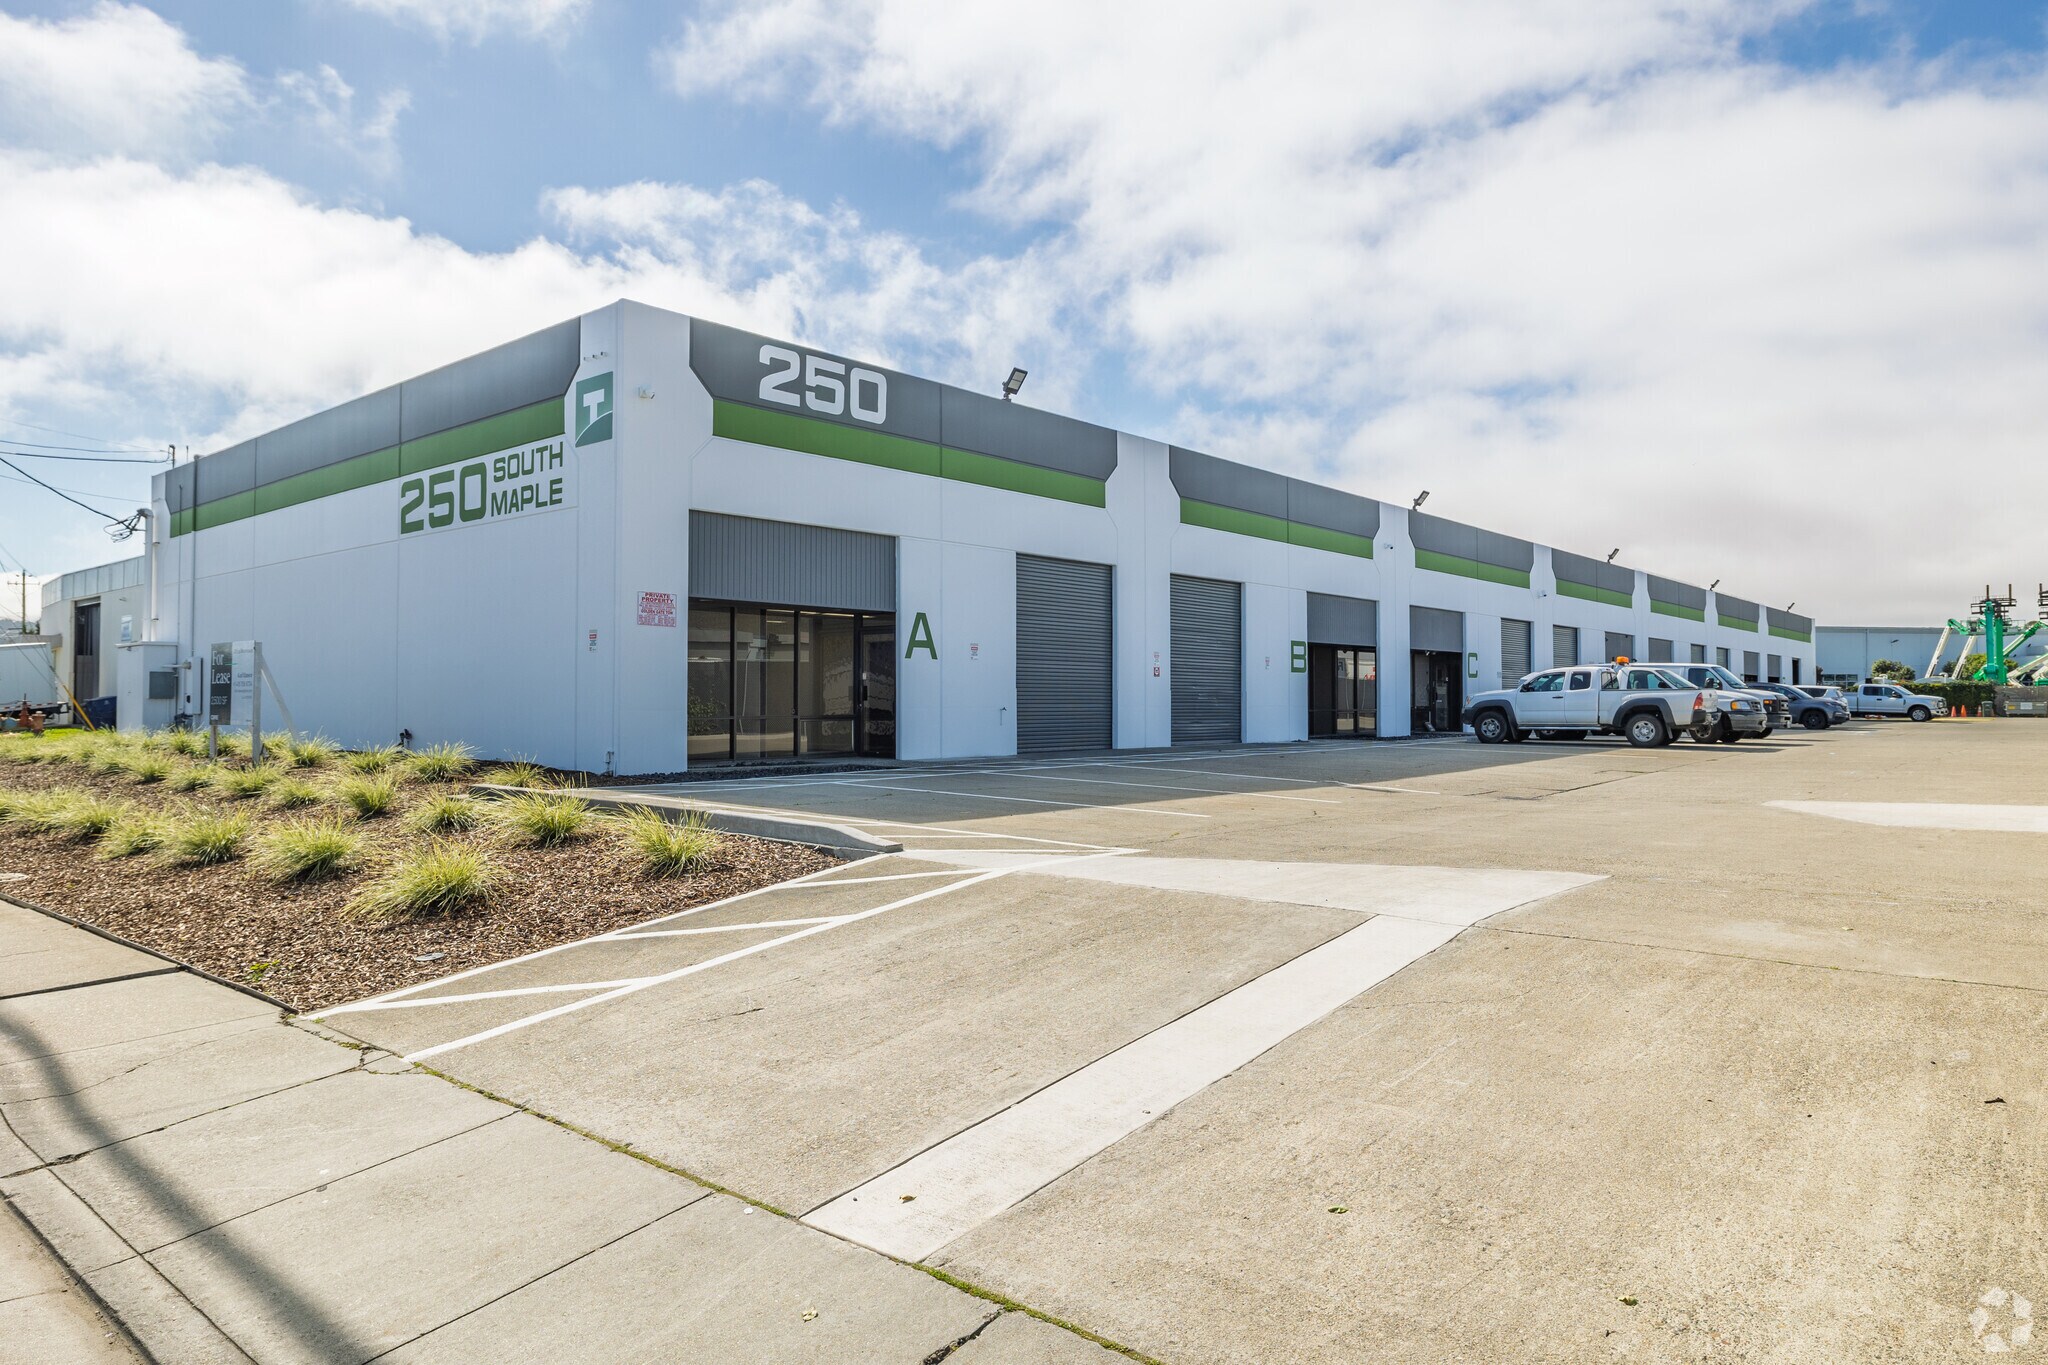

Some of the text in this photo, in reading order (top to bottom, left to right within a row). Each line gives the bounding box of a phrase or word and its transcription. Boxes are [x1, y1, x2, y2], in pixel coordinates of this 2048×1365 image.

[759, 344, 888, 425] 250
[493, 441, 564, 483] SOUTH
[400, 461, 487, 535] 250
[491, 477, 563, 517] MAPLE
[904, 612, 938, 660] A
[211, 669, 231, 684] Lease
[212, 650, 224, 666] For
[1290, 640, 1307, 673] B
[1467, 652, 1479, 679] C
